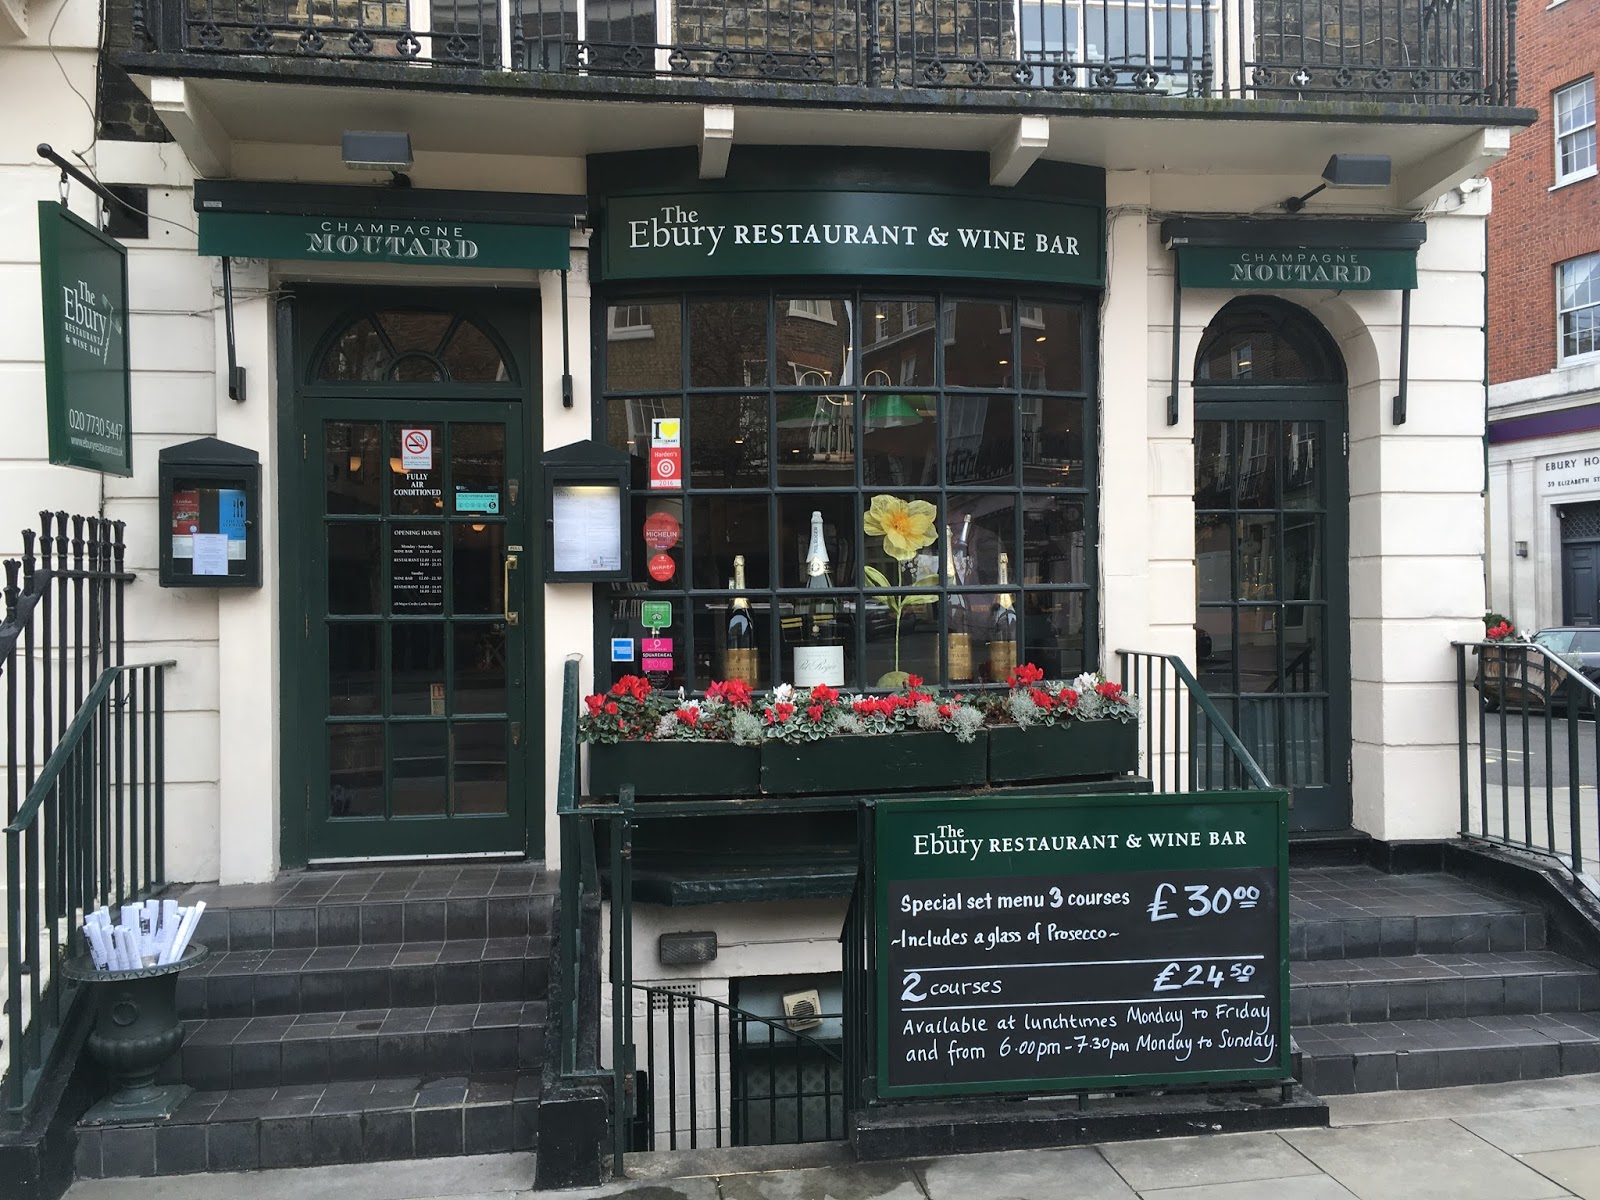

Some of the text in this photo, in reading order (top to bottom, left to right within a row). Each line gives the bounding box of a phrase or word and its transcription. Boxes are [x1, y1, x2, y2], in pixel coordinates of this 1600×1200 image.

[661, 205, 699, 224] The
[321, 221, 463, 238] CHAMPAGNE
[628, 217, 1080, 256] Ebury RESTAURANT & WINE BAR
[305, 233, 479, 260] MOUTARD
[1241, 253, 1359, 264] CHAMPAGNE
[1229, 263, 1371, 283] MOUTARD
[78, 280, 96, 306] The
[62, 285, 107, 346] Ebury
[64, 321, 101, 345] RESTAURANT
[65, 334, 101, 357] & WINE BAR
[69, 408, 123, 441] 020 7730 5447
[653, 421, 662, 439] I
[406, 473, 429, 481] FULLY
[1545, 459, 1577, 472] EBURY
[393, 488, 442, 496] CONDITIONED
[1557, 477, 1590, 487] ELIZABETH
[647, 660, 668, 669] 2016
[937, 824, 965, 838] The
[913, 831, 1247, 861] Ebury RESTAURANT & WINE BAR
[900, 886, 1131, 917] Special set menu 3 courses
[974, 935, 985, 945] a
[985, 926, 1022, 950] glass
[1027, 922, 1041, 944] of
[900, 972, 1002, 1002] 2 courses
[903, 1002, 1271, 1036] Available at lunchtimes Monday to Friday
[906, 1038, 939, 1062] and
[947, 1039, 986, 1067] from
[1135, 1033, 1193, 1062] Monday
[1197, 1035, 1213, 1050] to
